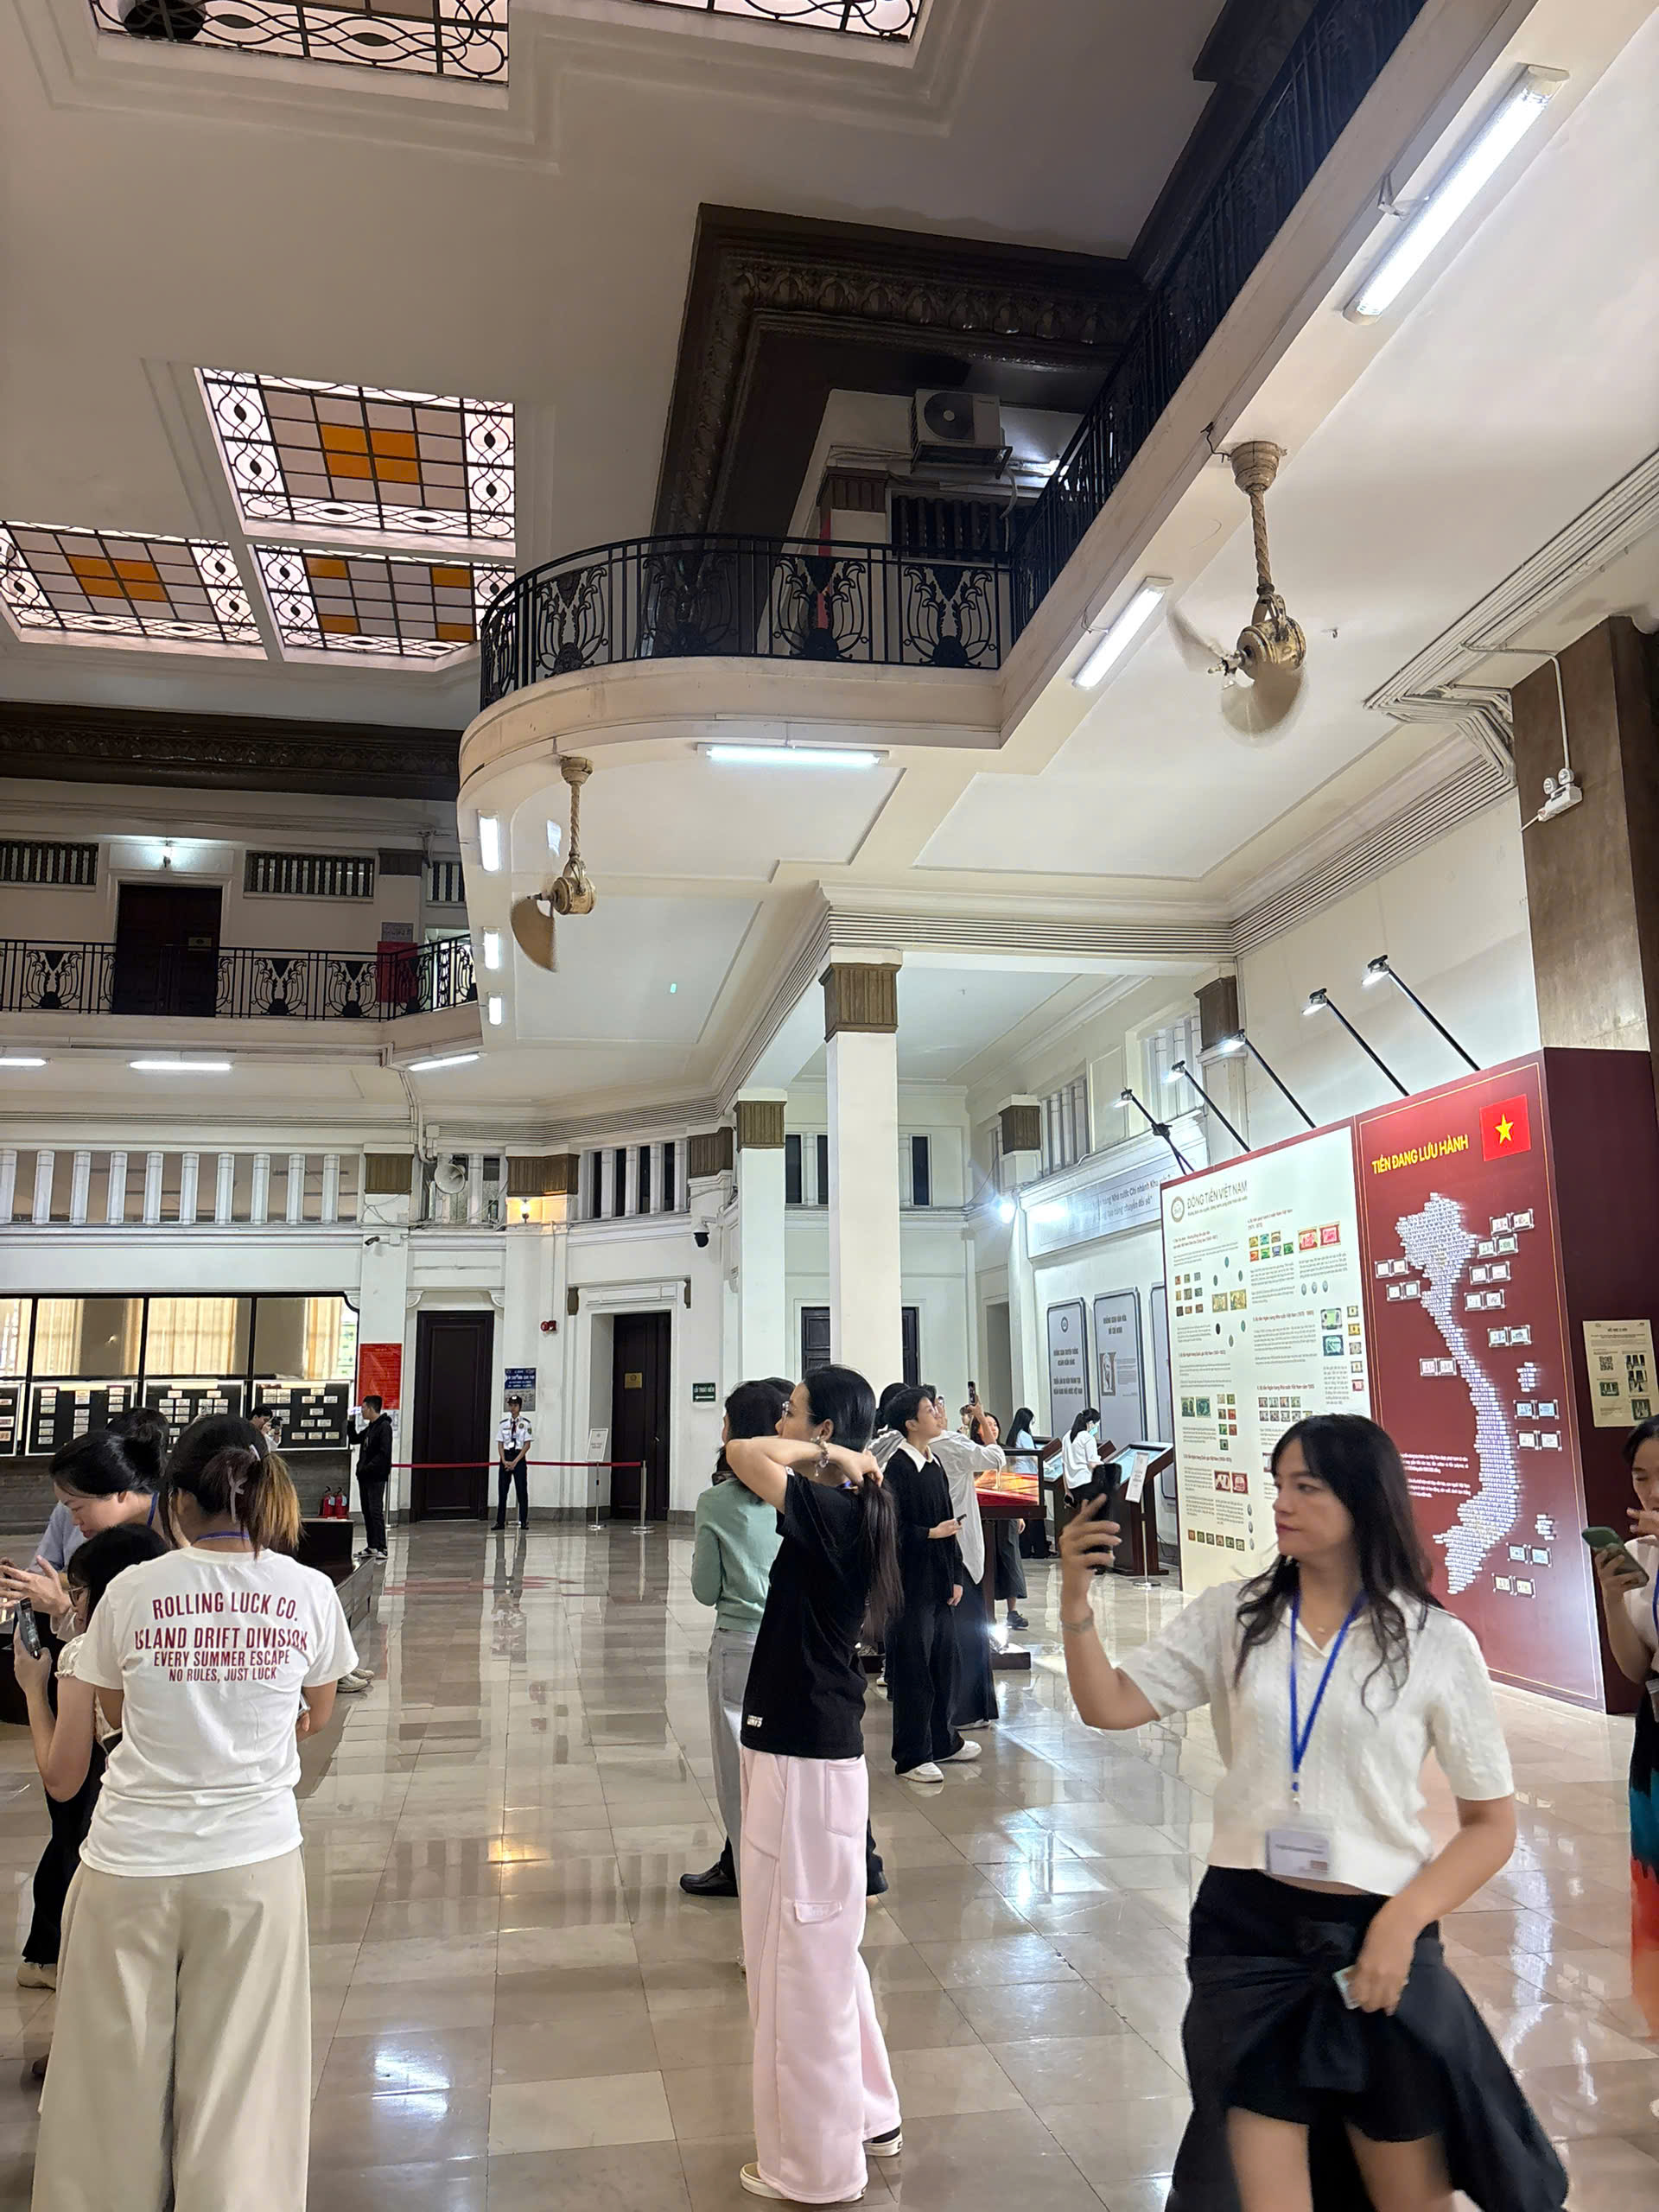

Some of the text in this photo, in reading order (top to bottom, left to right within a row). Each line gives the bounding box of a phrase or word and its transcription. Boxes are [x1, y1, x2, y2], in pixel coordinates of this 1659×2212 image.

[1371, 1134, 1469, 1174] TIỀN ĐANG LƯU HÀNH
[1232, 1179, 1248, 1195] NAM
[152, 1591, 299, 1622] ROLLING LUCK CO.
[194, 1627, 241, 1649] DRIFT
[246, 1627, 308, 1651] DIVISION
[154, 1649, 290, 1667] EVERY SUMMER ESCAPE
[168, 1667, 277, 1683] NO RULES, JUST LUCK
